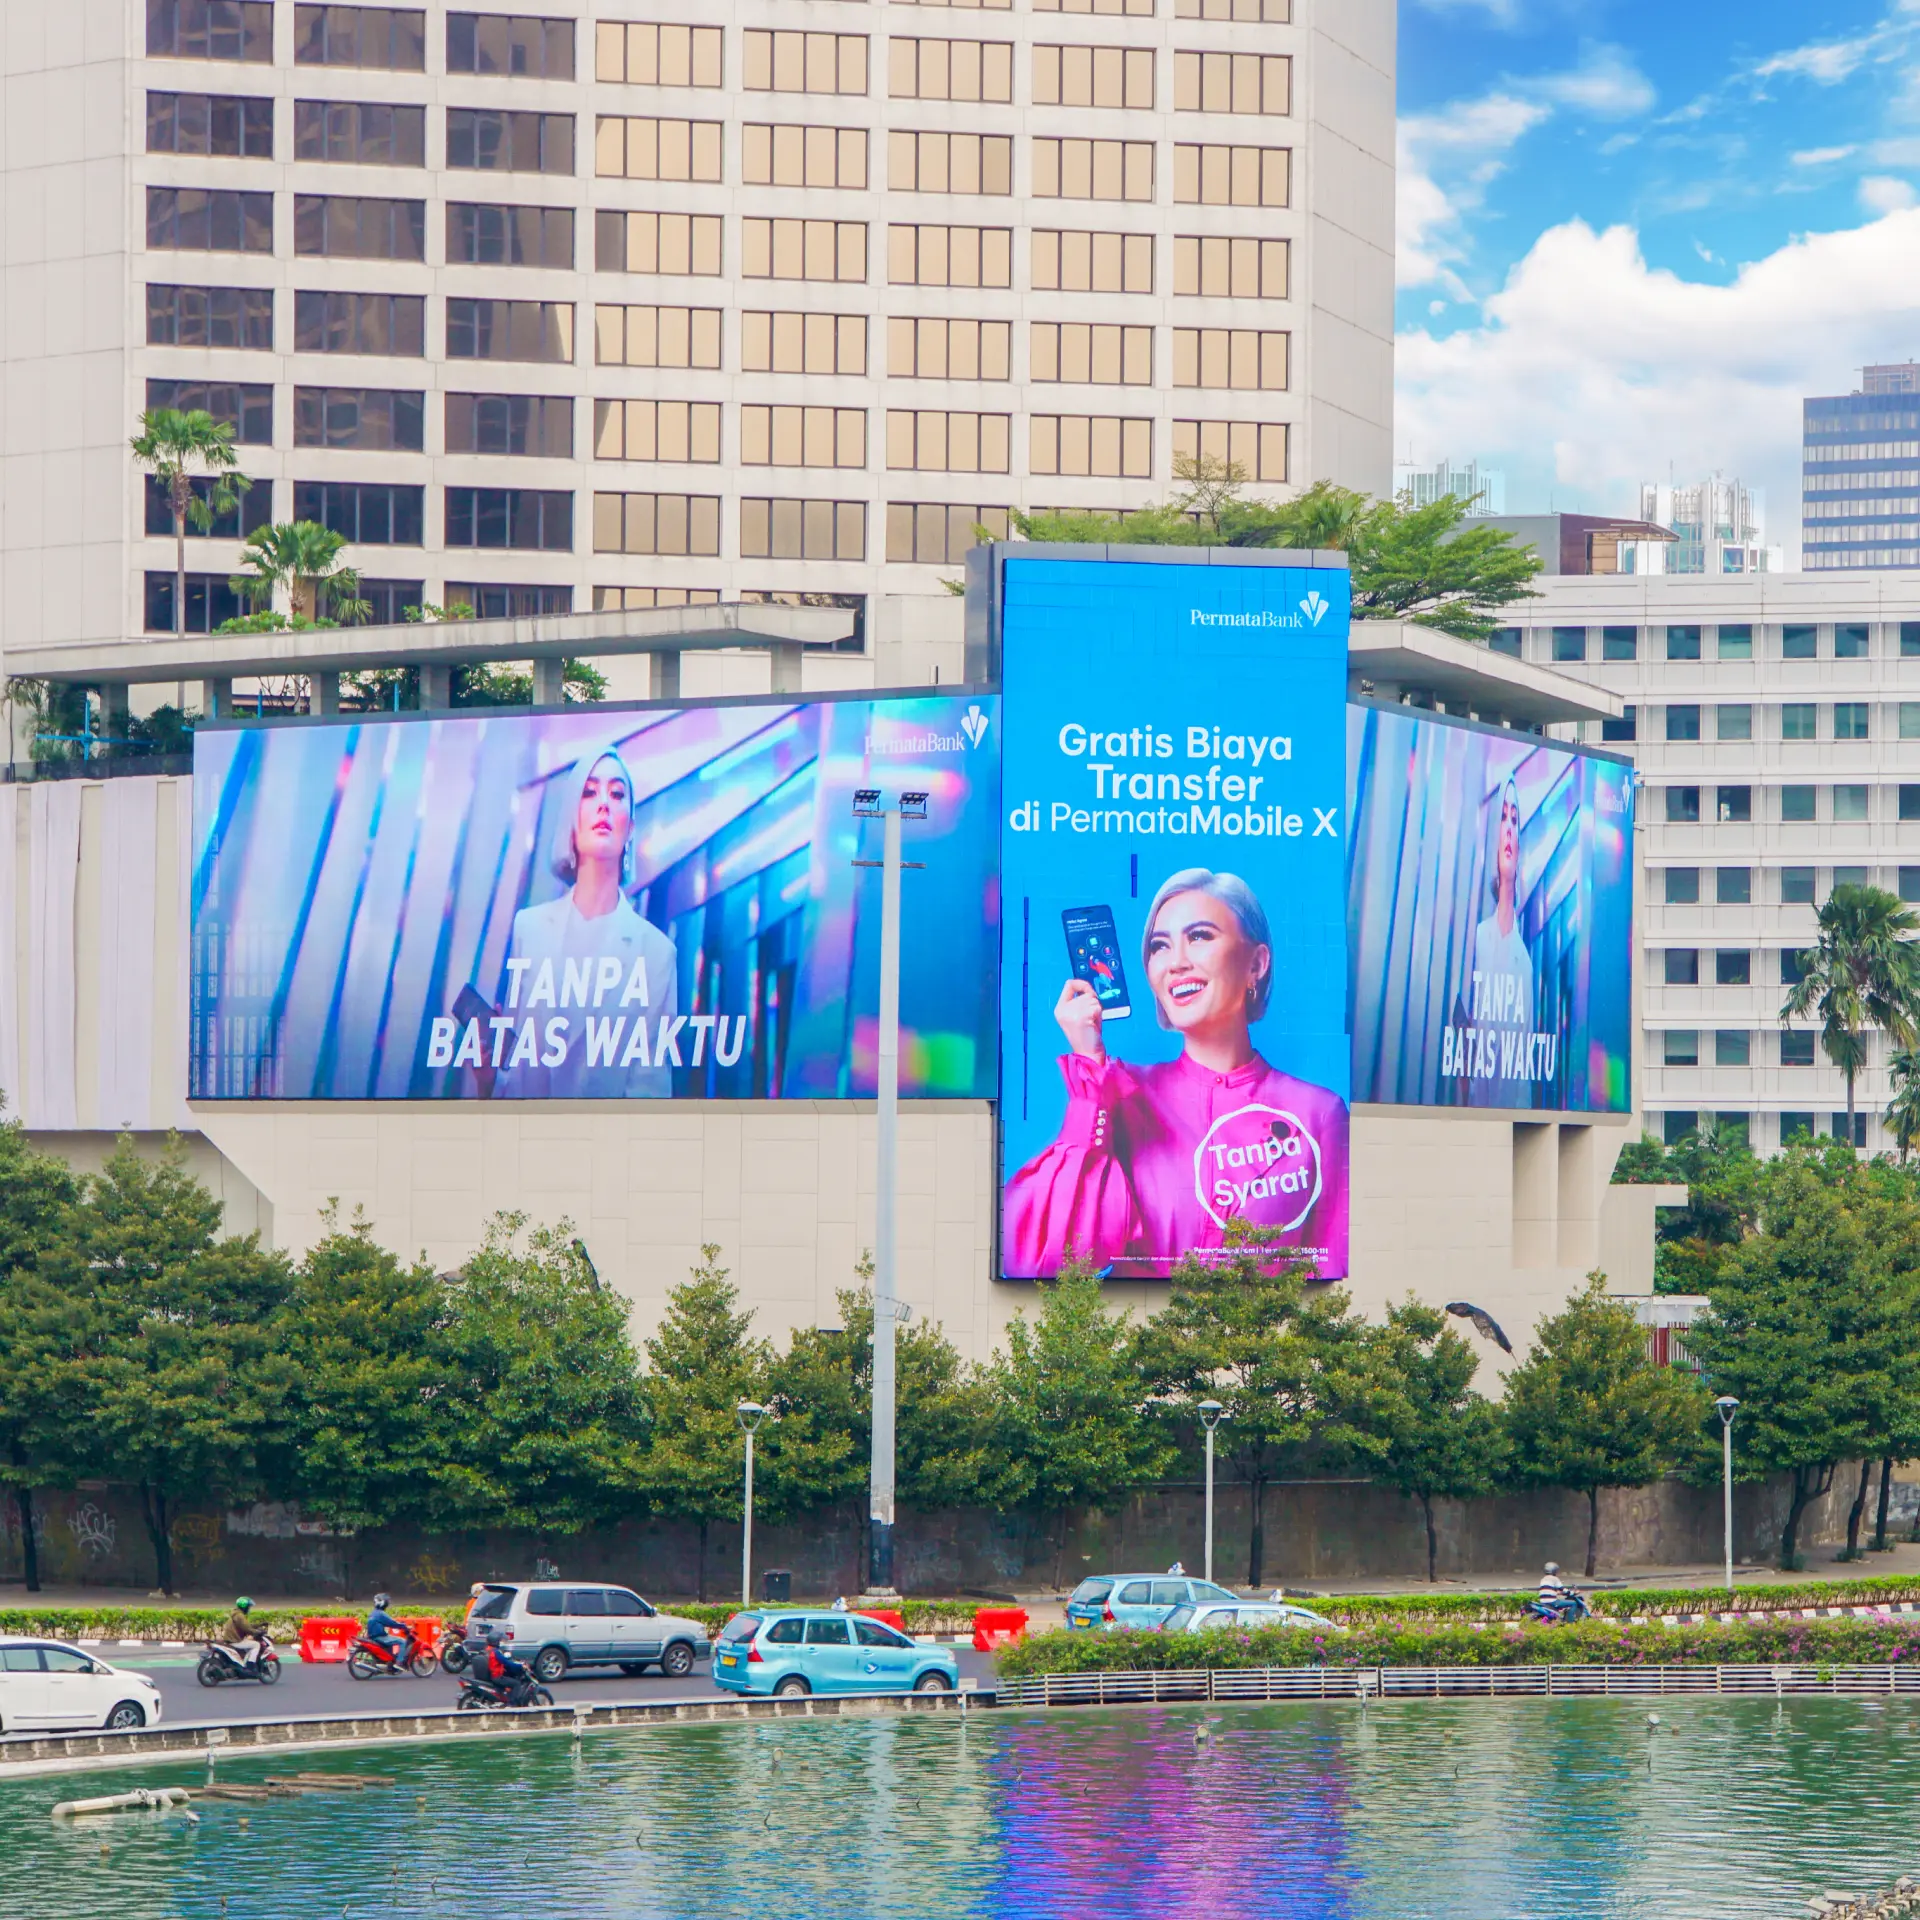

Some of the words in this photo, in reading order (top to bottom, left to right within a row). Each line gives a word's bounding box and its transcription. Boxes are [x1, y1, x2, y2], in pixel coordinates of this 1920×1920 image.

[1190, 609, 1303, 628] PermataBank
[864, 731, 965, 754] PermataBank
[1058, 723, 1174, 758] Gratis
[1187, 725, 1292, 767] Biaya
[1087, 763, 1264, 801] Transfer
[1009, 801, 1040, 831] di
[1051, 802, 1303, 837] PermataMobile
[1311, 807, 1338, 837] X
[506, 956, 650, 1008] TANPA
[1473, 970, 1524, 1023] TANPA
[426, 1016, 570, 1068] BATAS
[585, 1015, 746, 1068] WAKTU
[1442, 1026, 1496, 1079] BATAS
[1501, 1031, 1556, 1082] WAKTU
[1208, 1136, 1302, 1170] Tanpa
[1214, 1166, 1309, 1208] Syarat
